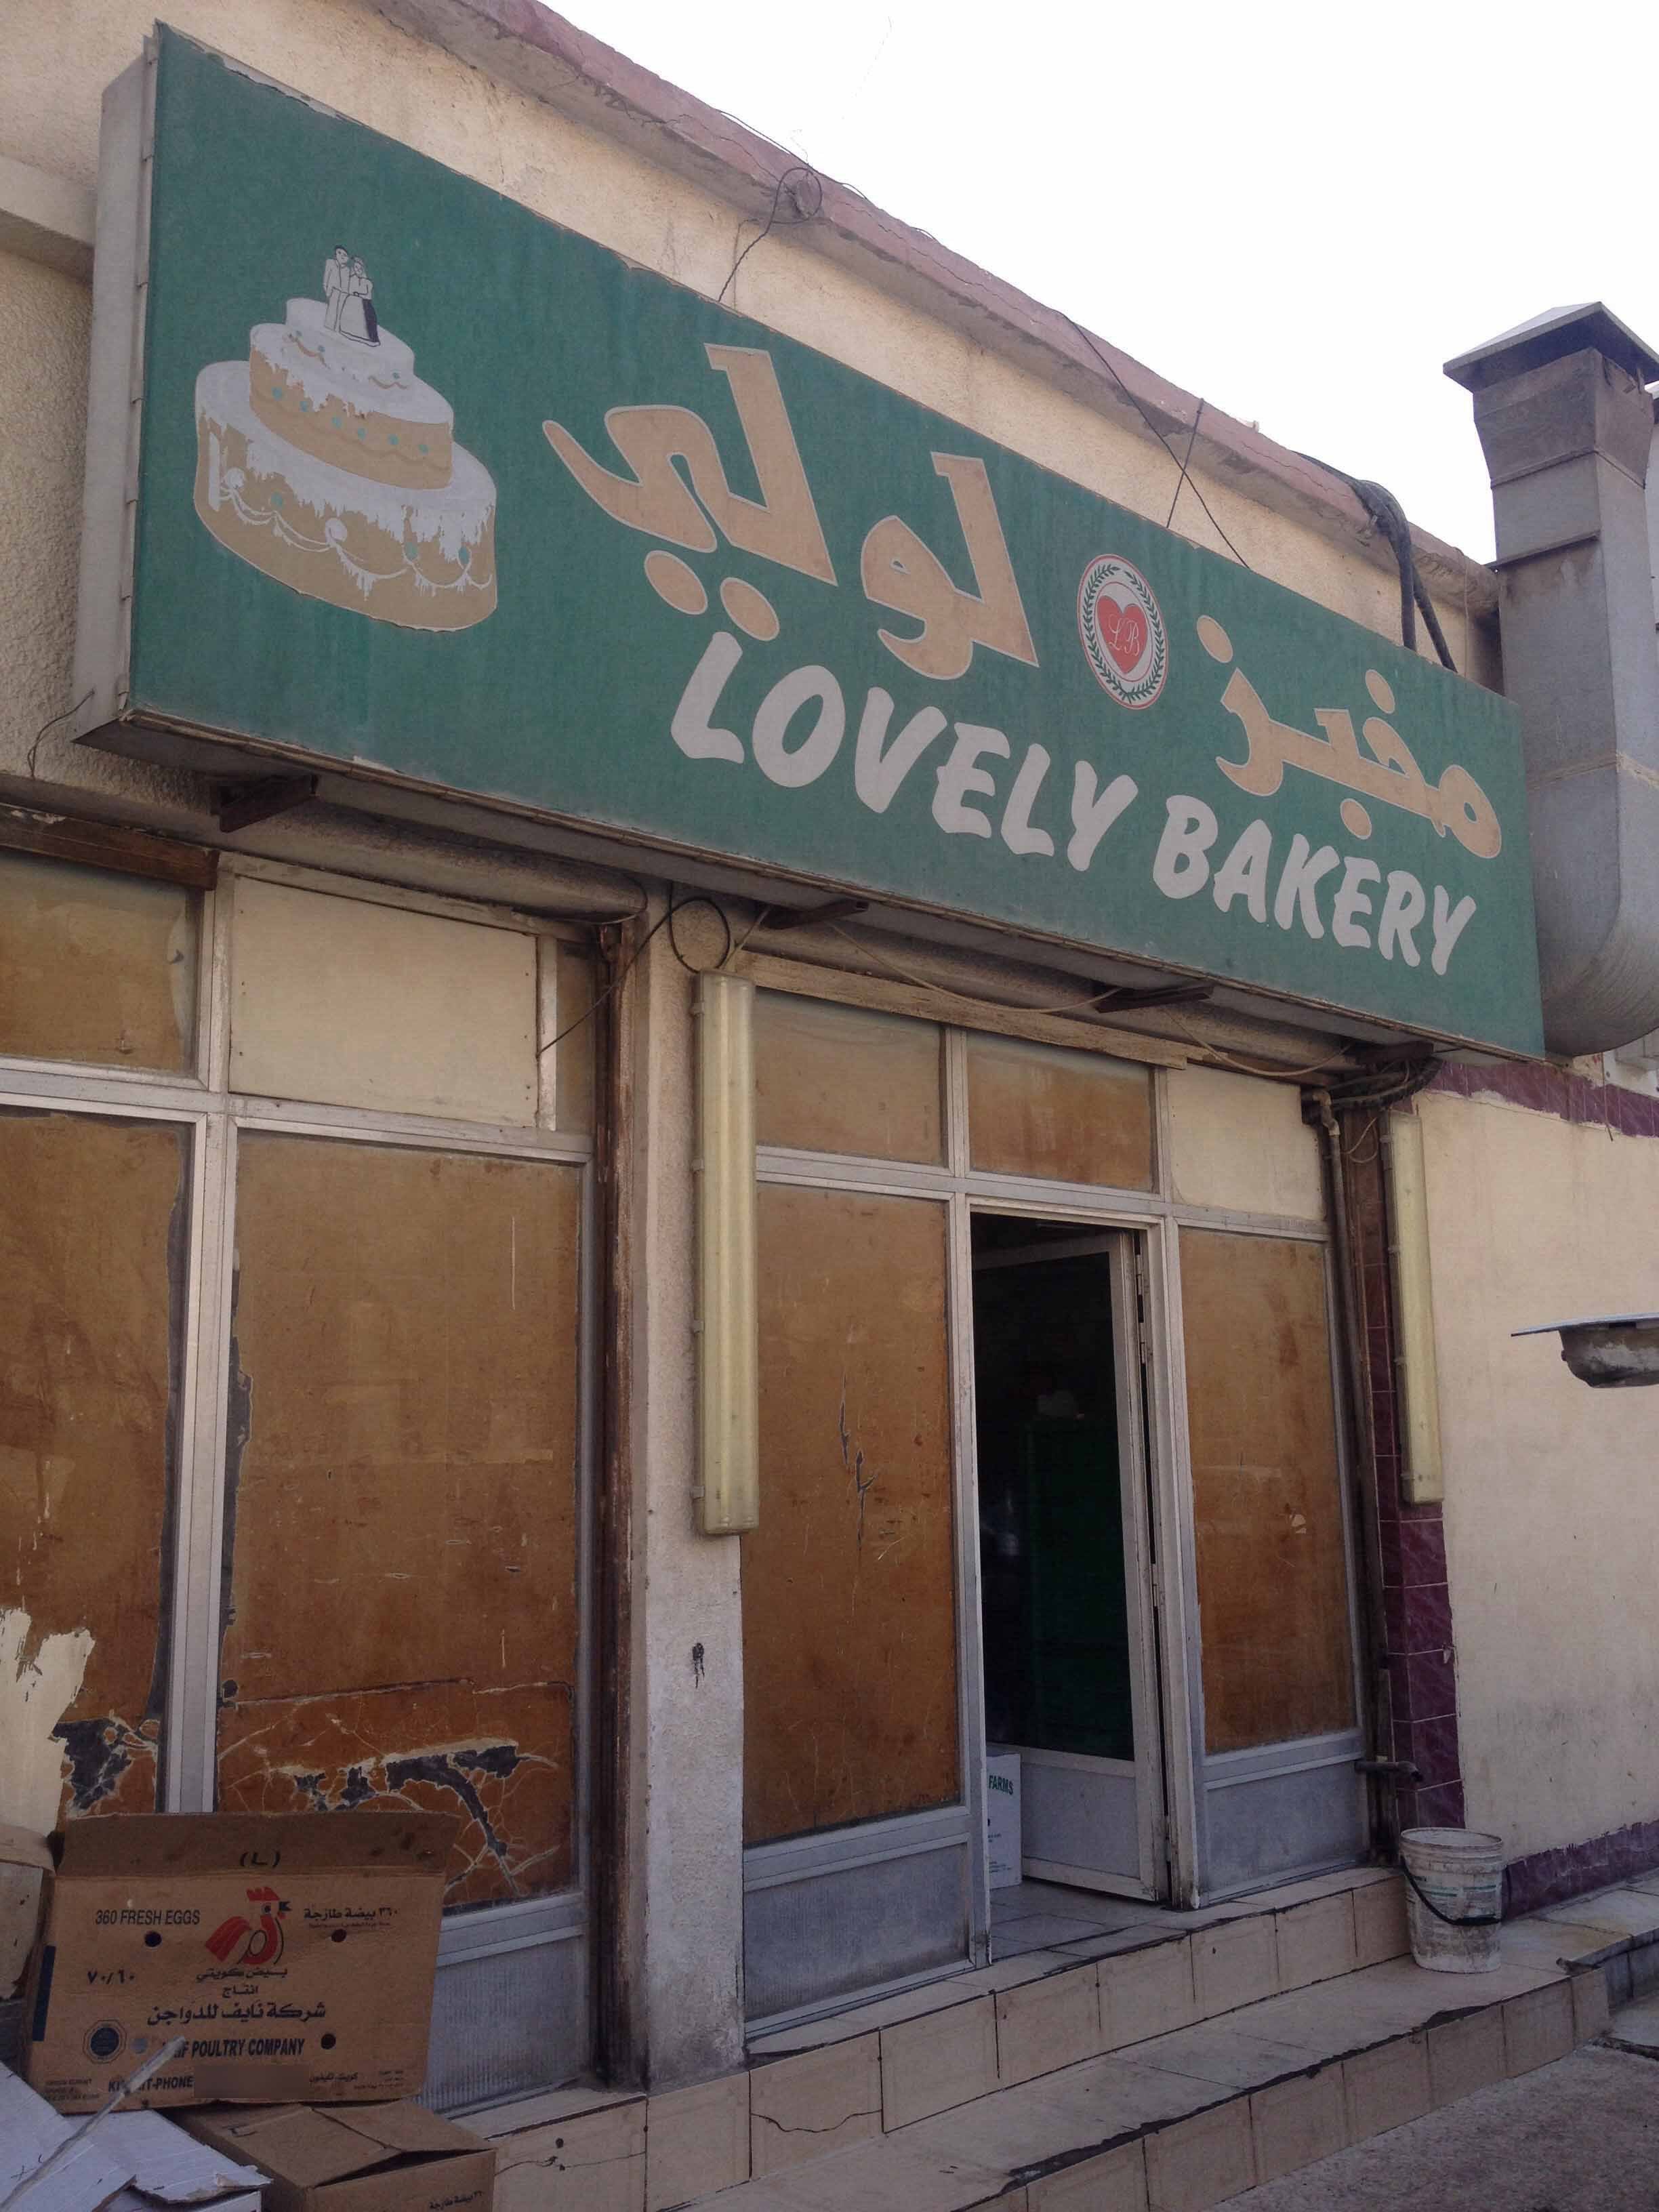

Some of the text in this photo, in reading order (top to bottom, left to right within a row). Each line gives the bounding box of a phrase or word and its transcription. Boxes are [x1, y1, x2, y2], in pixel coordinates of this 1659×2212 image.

[1197, 615, 1502, 859] مخبز
[670, 631, 1477, 975] LOVELY BAKERY
[988, 1774, 1014, 1795] FARMS
[94, 1908, 201, 1925] 360 FRESH EGGS
[303, 1906, 342, 1921] طازجة
[344, 1906, 376, 1920] بيضة
[196, 1967, 244, 1982] كويتي
[146, 2001, 326, 2026] شركة نايف للدواجن
[192, 2039, 246, 2057] POULTRY
[248, 2038, 305, 2055] COMPANY
